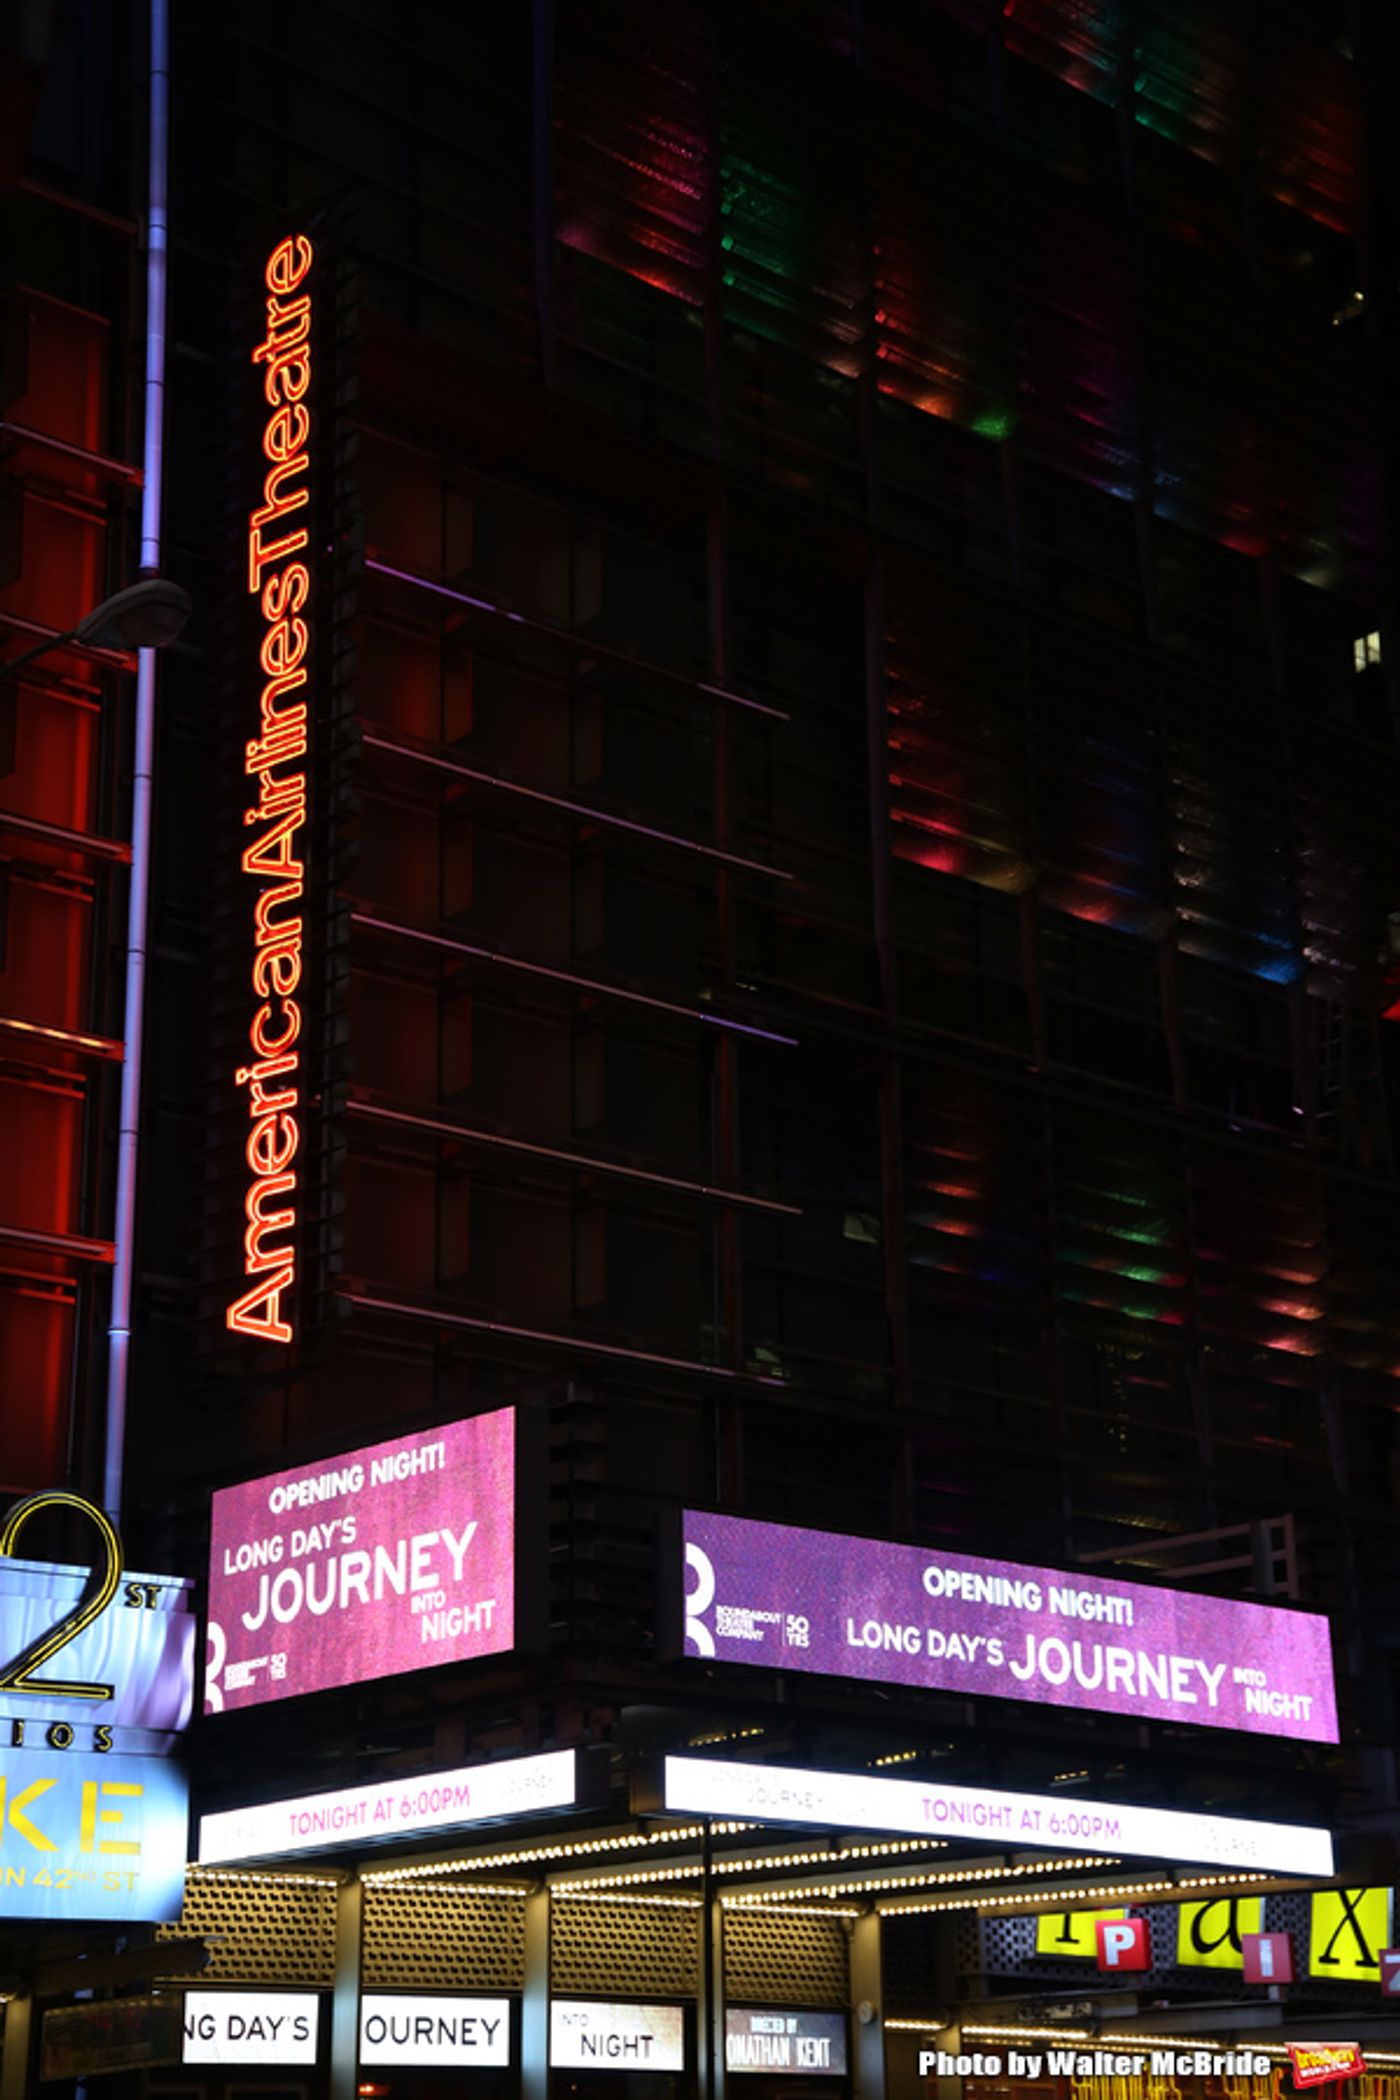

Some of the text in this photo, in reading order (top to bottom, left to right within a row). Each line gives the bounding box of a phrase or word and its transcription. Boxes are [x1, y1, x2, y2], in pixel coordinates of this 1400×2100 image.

[268, 1442, 447, 1514] OPENING NIGHT!
[224, 1515, 357, 1576] LONG DAY'S
[242, 1520, 478, 1631] JOURNEY
[124, 1582, 161, 1610] ST
[411, 1590, 446, 1614] INTO
[922, 1566, 1134, 1627] OPENING NIGHT!
[421, 1599, 497, 1643] NIGHT
[847, 1617, 1228, 1708] LONG DAY'S JOURNEY
[1233, 1666, 1267, 1688] INTO
[1245, 1687, 1314, 1723] NIGHT
[289, 1801, 368, 1837] TONIGHT
[373, 1797, 394, 1822] AT
[400, 1784, 471, 1819] 6:00PM
[921, 1797, 1121, 1840] TONIGHT AT 6:00PM
[102, 1871, 140, 1891] ST
[227, 2014, 310, 2042] DAY'S
[365, 2013, 502, 2047] OURNEY
[580, 2032, 655, 2058] NIGHT
[796, 2037, 831, 2067] KENT
